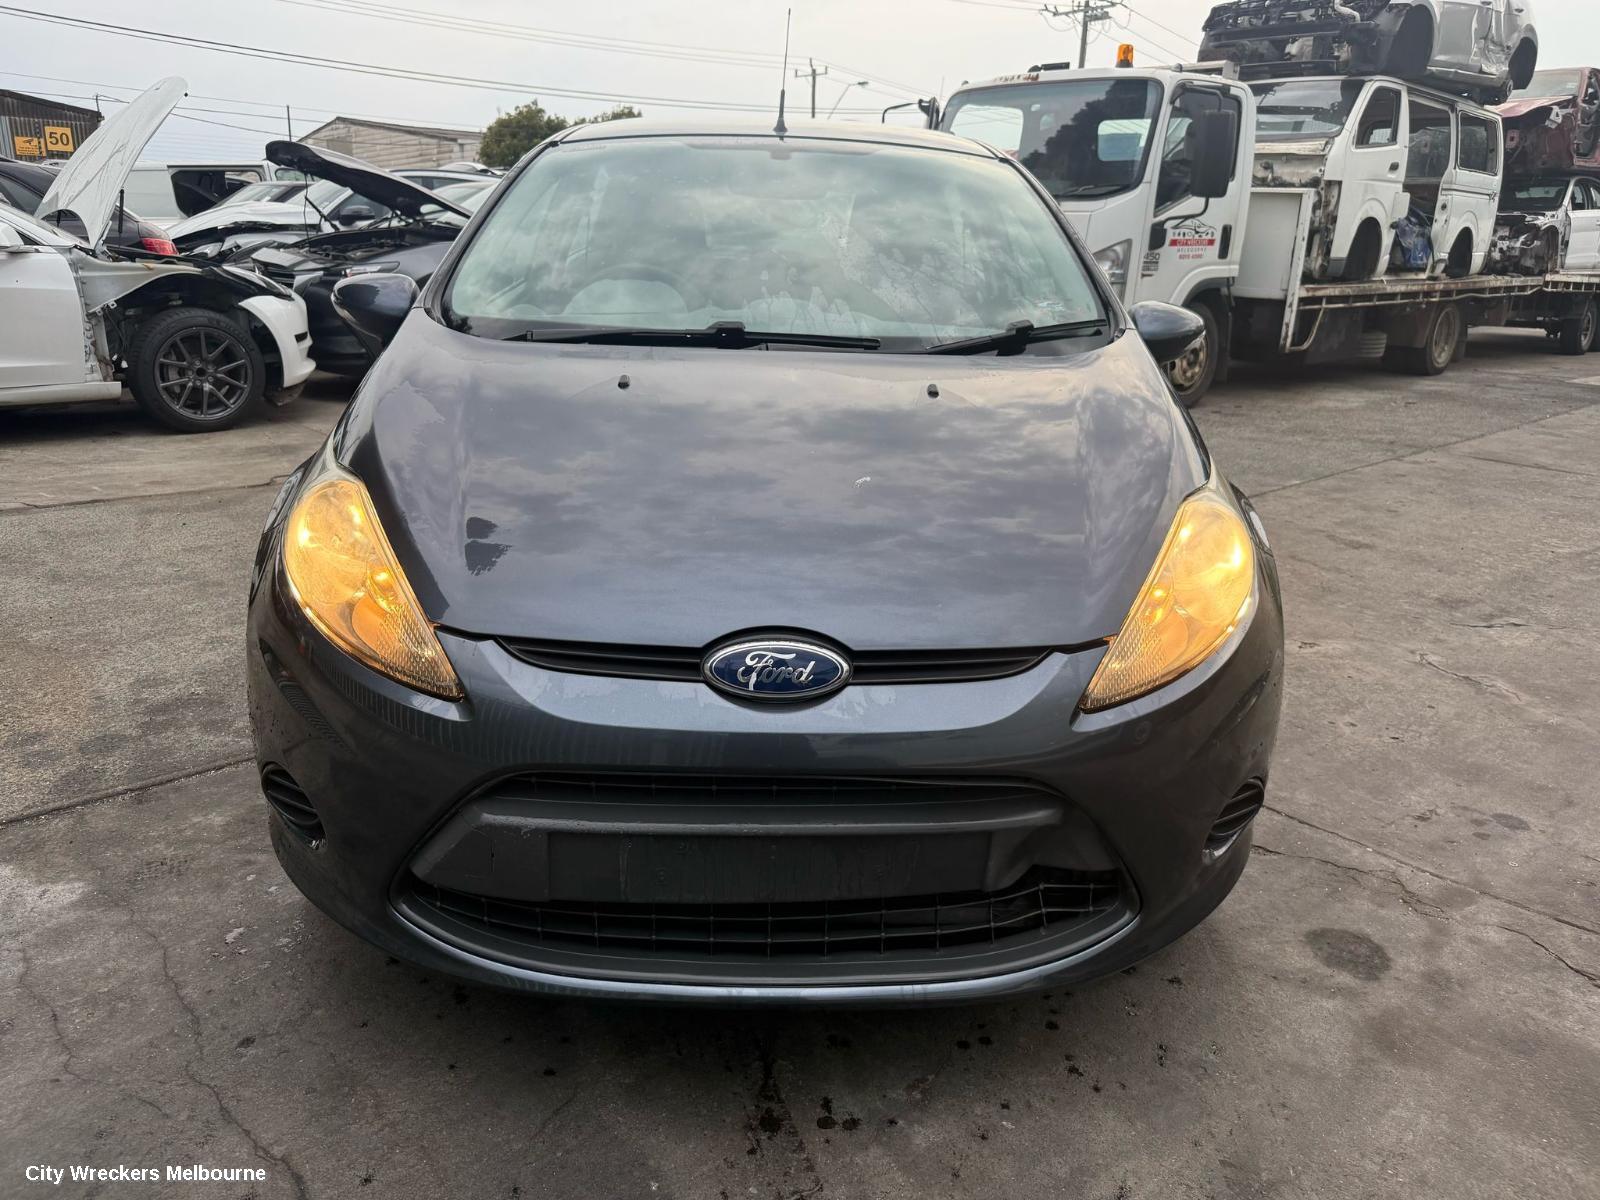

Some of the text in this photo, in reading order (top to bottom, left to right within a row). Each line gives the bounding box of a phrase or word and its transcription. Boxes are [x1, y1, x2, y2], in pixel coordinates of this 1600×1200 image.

[49, 131, 70, 146] 50
[1143, 252, 1161, 260] 450
[736, 650, 816, 691] Ford
